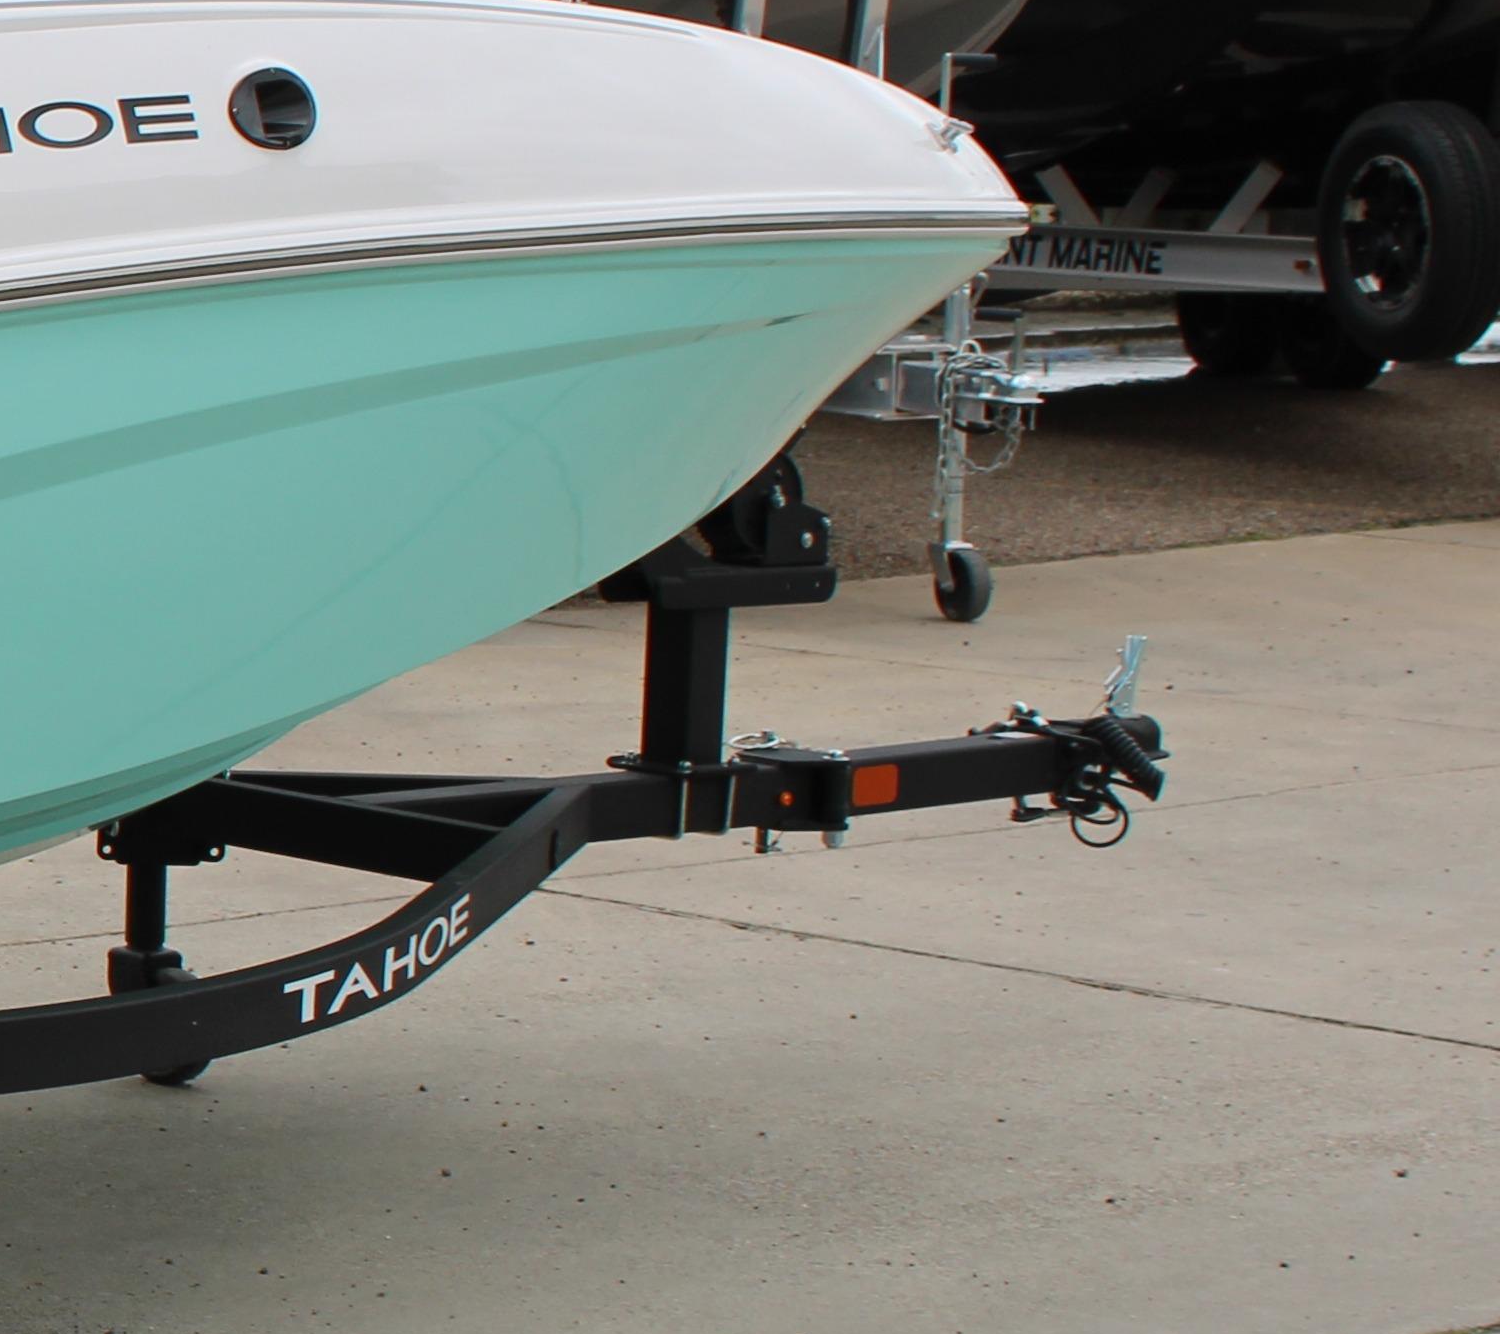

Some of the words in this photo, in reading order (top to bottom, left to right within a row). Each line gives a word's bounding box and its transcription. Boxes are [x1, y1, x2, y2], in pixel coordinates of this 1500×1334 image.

[998, 235, 1043, 267] NT
[1049, 237, 1168, 276] MARINE
[283, 893, 472, 1024] TAHOE
